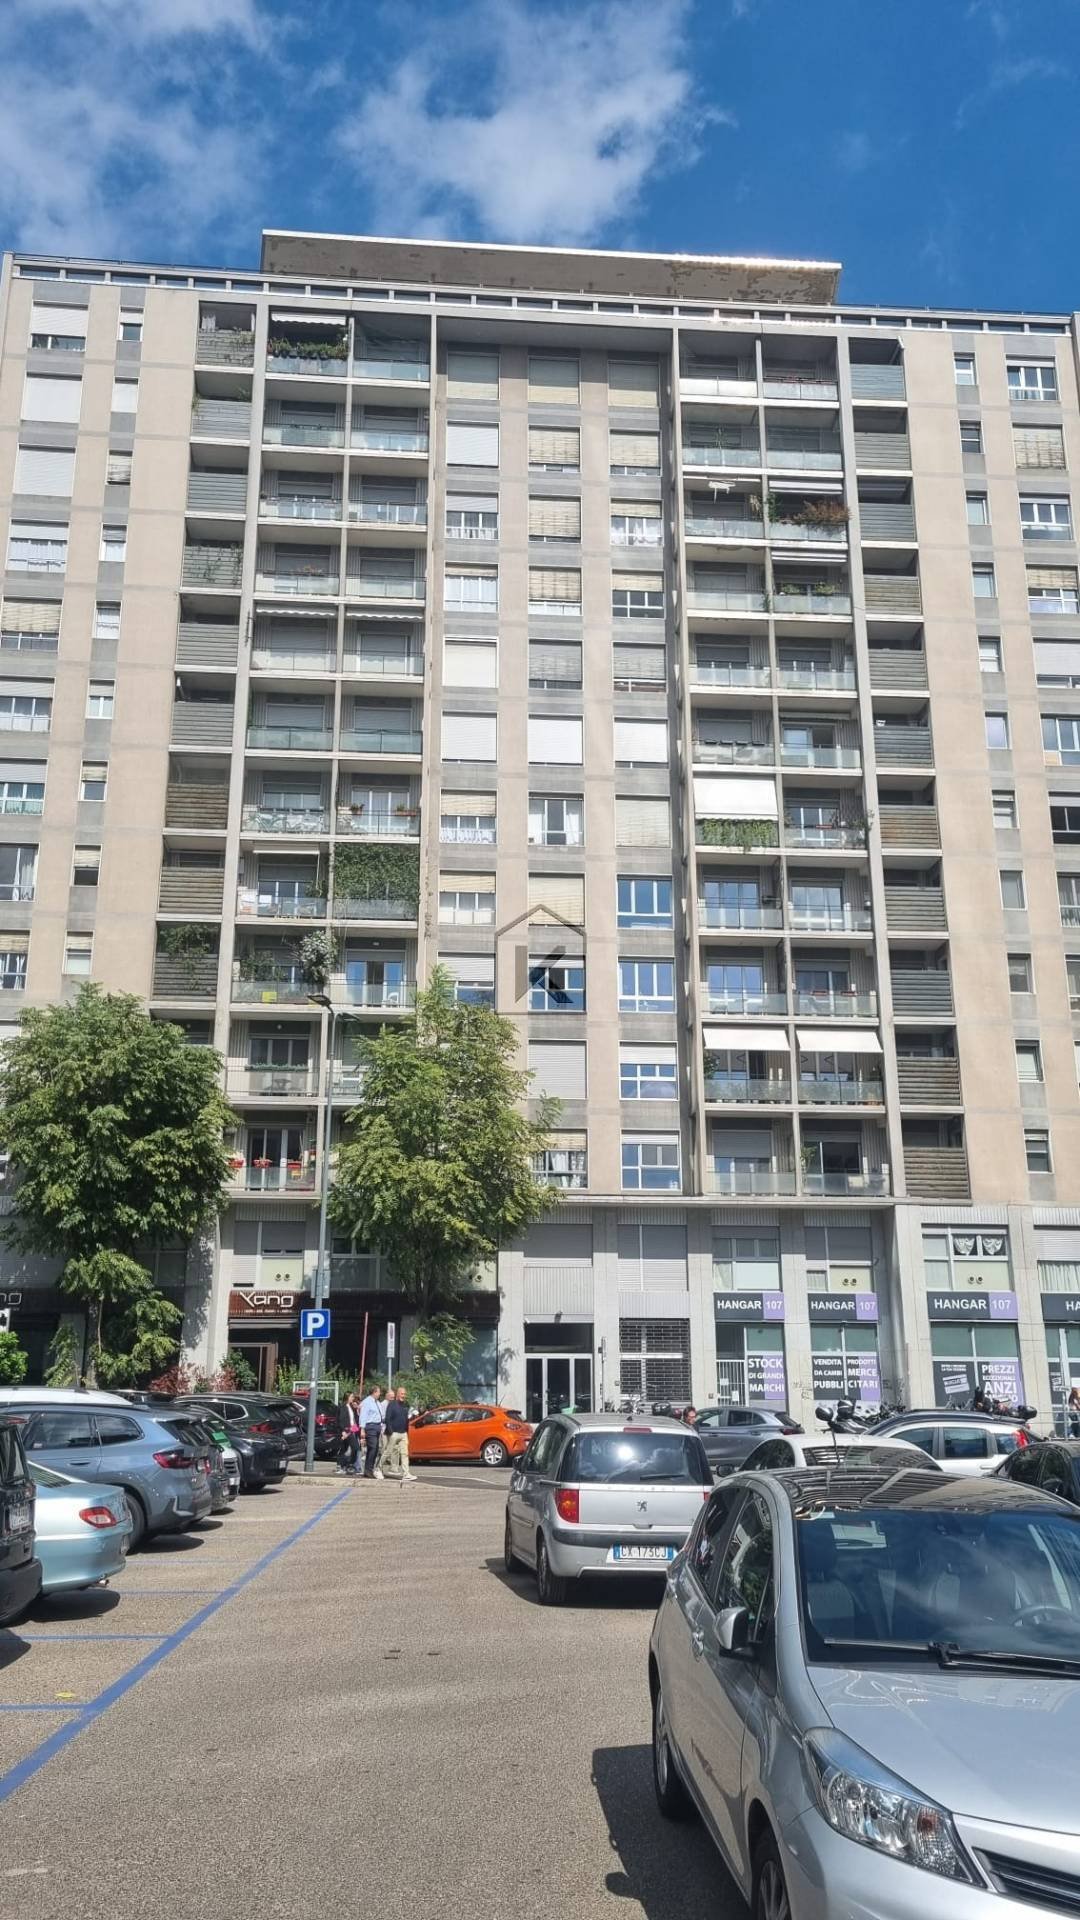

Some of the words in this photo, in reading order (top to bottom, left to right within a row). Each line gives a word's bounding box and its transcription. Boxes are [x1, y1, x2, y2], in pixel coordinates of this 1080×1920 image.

[240, 1291, 294, 1308] Yang
[934, 1299, 987, 1309] HANGAR
[992, 1300, 1011, 1309] 107
[717, 1300, 762, 1310] HANGAR
[765, 1301, 783, 1310] 107
[811, 1301, 856, 1310] HANGAR
[859, 1301, 876, 1310] 107
[307, 1313, 325, 1336] P
[748, 1358, 784, 1368] STOCK
[813, 1358, 842, 1366] VENDITA
[847, 1358, 877, 1366] PRODOTTI
[847, 1368, 878, 1377] MERCE
[981, 1364, 1016, 1374] PREZZI
[750, 1383, 785, 1392] MARCHI
[814, 1380, 844, 1389] PUBBLI
[848, 1380, 878, 1389] CITARI
[984, 1381, 1017, 1394] ANZI
